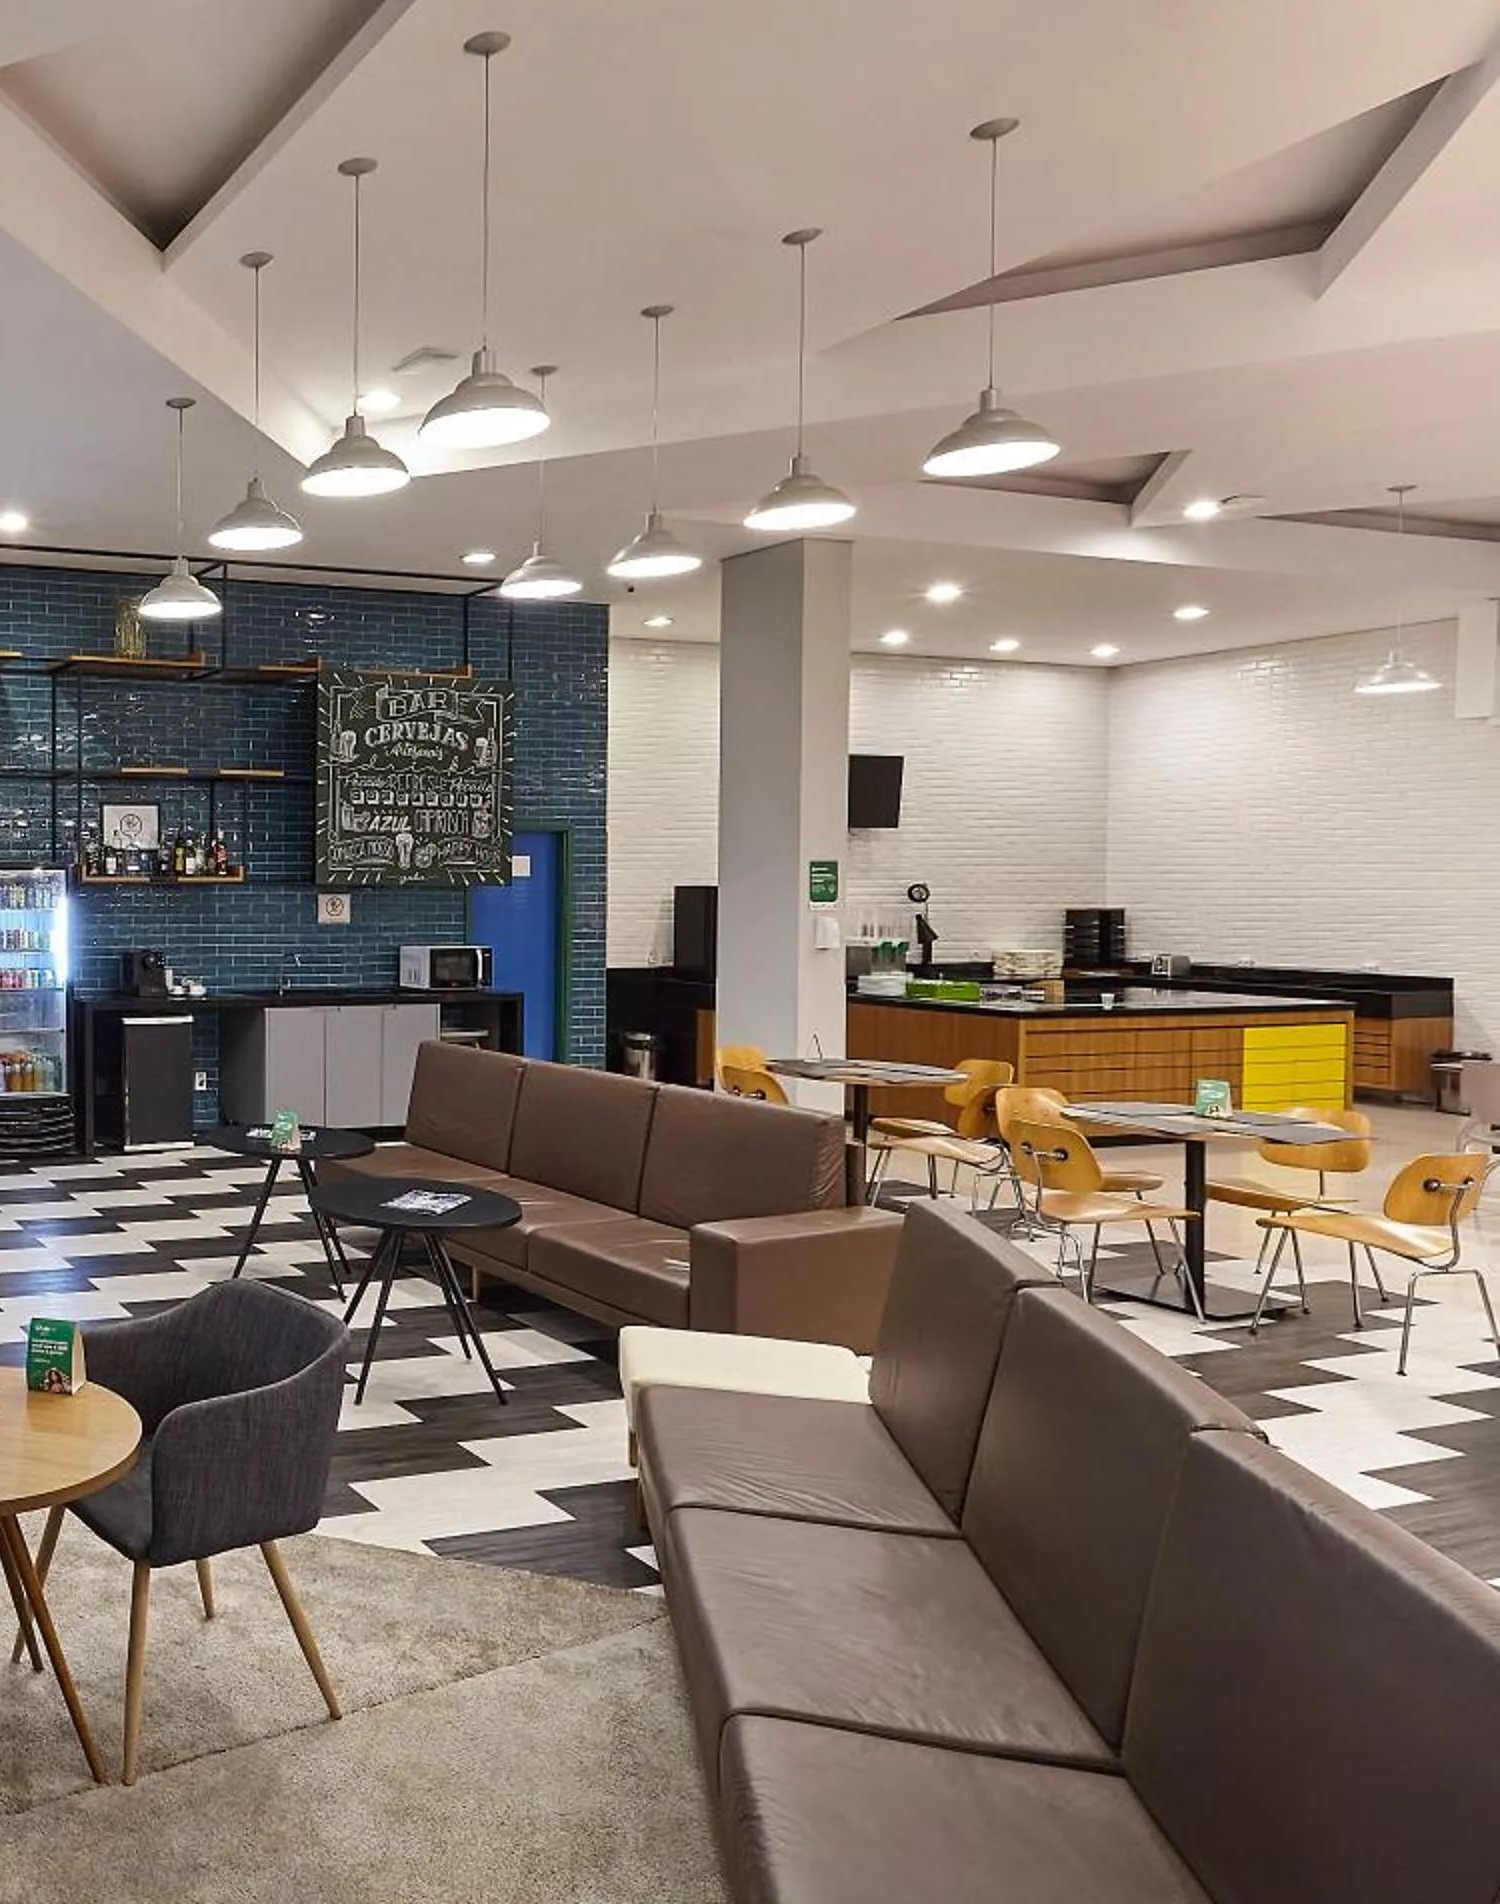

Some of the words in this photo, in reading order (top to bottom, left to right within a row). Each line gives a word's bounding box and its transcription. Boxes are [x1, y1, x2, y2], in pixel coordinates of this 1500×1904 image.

[388, 691, 448, 717] BAR
[365, 722, 469, 750] CERVEJAS
[368, 815, 412, 831] AZUL
